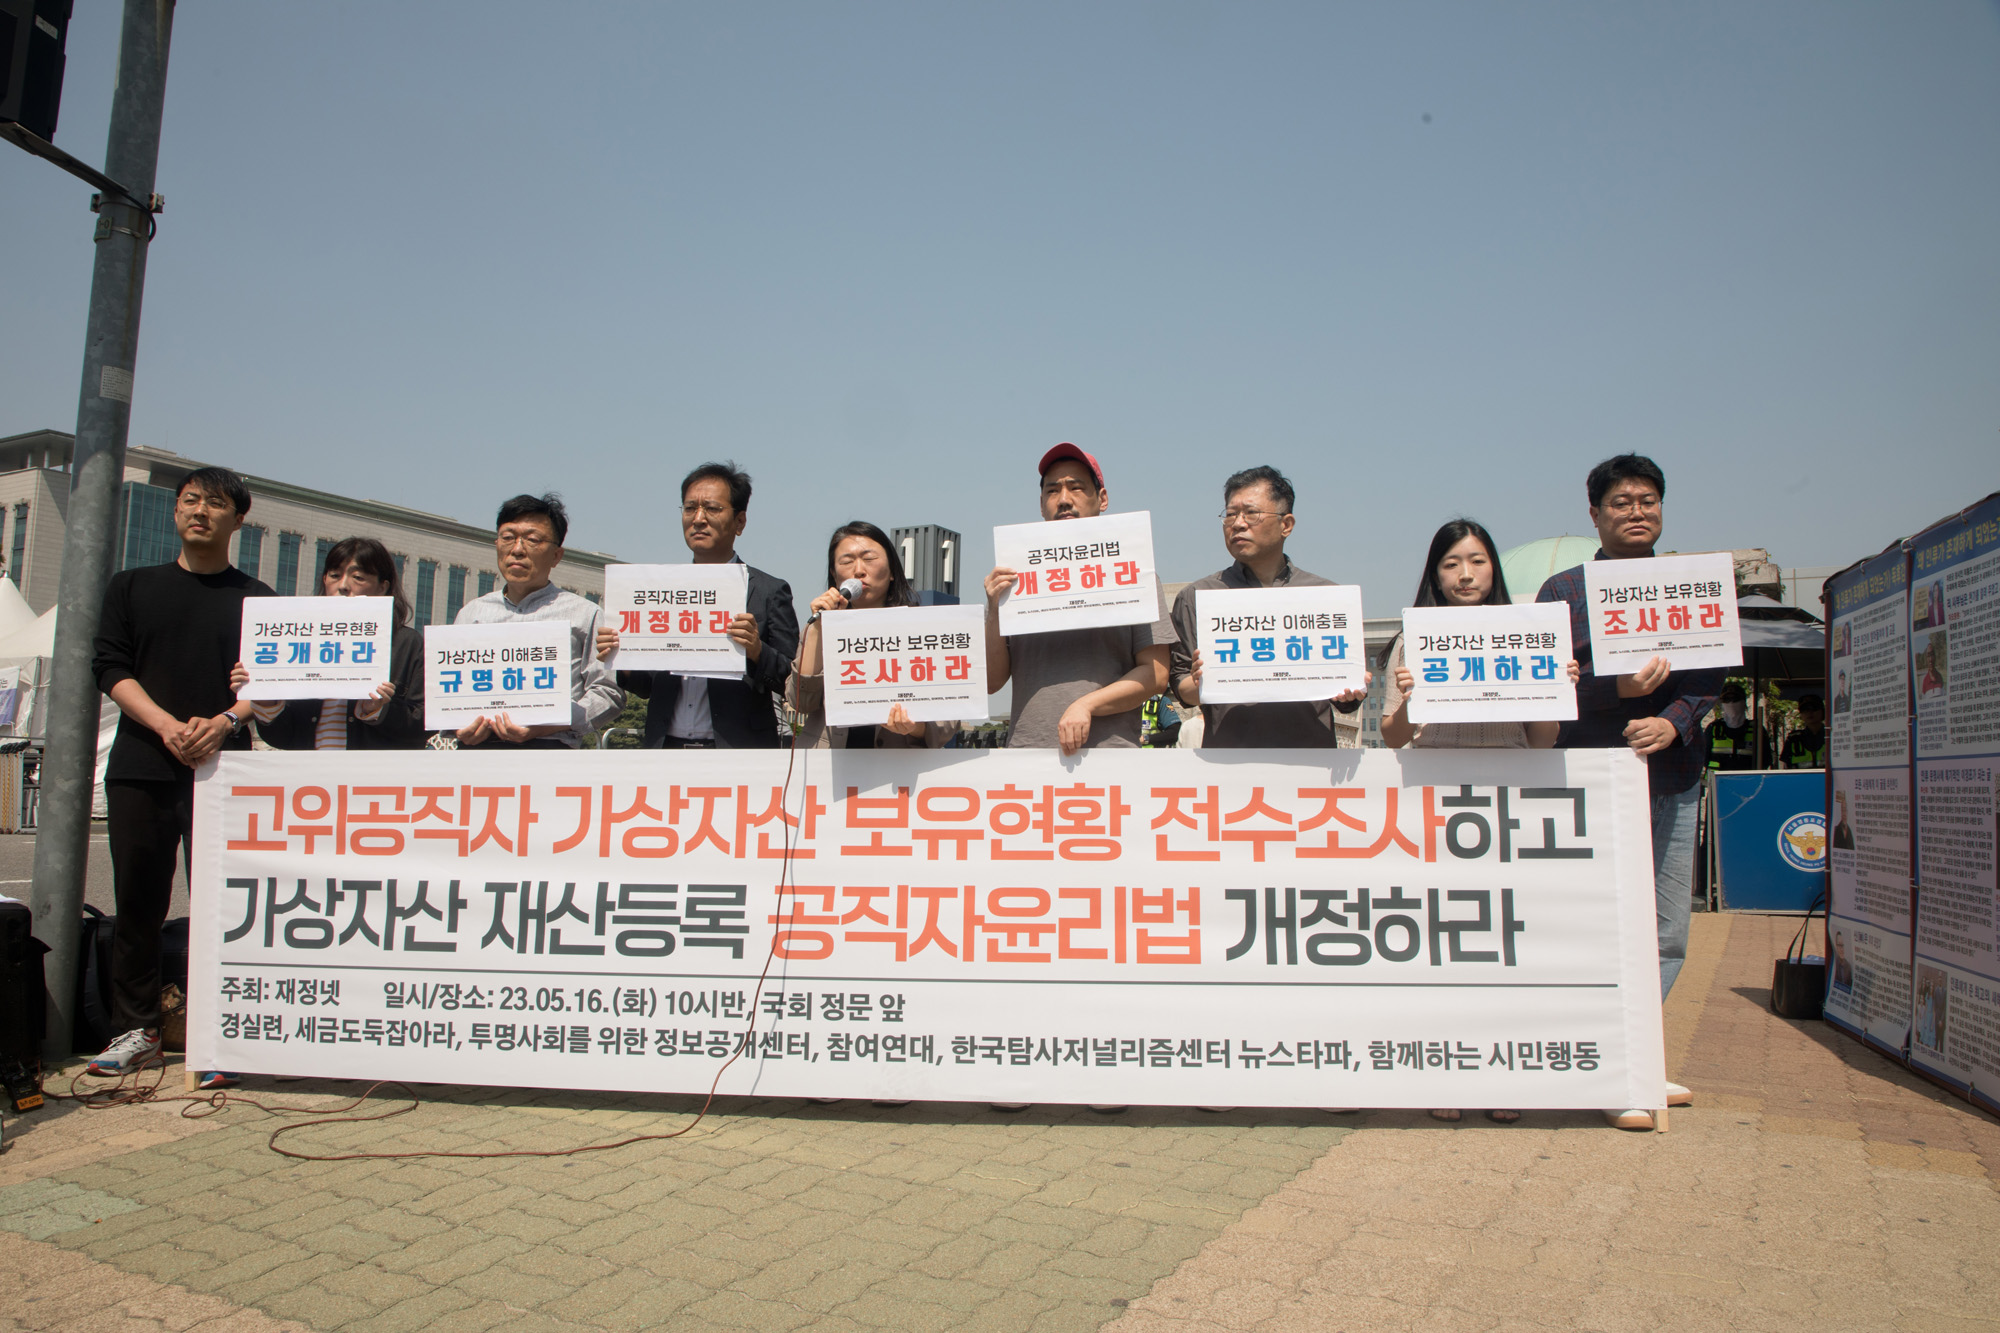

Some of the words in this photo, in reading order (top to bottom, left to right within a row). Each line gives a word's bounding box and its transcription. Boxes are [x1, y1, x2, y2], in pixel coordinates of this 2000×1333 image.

[1027, 540, 1120, 565] 공직자윤리법
[1014, 560, 1141, 596] 개정하라
[633, 589, 717, 605] 공직자윤리법
[1599, 585, 1659, 604] 가상자산
[1664, 581, 1722, 600] 보유현황
[255, 622, 314, 637] 가상자산
[319, 621, 378, 636] 보유현황
[618, 609, 734, 634] 개정하라
[1211, 615, 1277, 633] 가상자산
[1283, 613, 1348, 630] 이해충돌
[1603, 603, 1725, 636] 조사하라
[254, 640, 376, 665] 공개하라
[837, 635, 902, 654] 가상자산
[907, 632, 971, 651] 보유현황
[1214, 635, 1349, 663] 규명하라
[1419, 634, 1485, 652] 가상자산
[1491, 632, 1557, 650] 보유현황
[437, 648, 496, 665] 가상자산
[501, 646, 558, 663] 이해충돌
[439, 666, 557, 693] 규명하라
[839, 655, 972, 686] 조사하라
[1422, 655, 1559, 683] 공개하라
[226, 784, 540, 858] 고위공직자
[552, 784, 827, 860] 가상자산
[839, 782, 1132, 862] 보유현황
[1150, 784, 1593, 863] 전수조사하고
[223, 876, 468, 953] 가상자산
[481, 880, 750, 959] 재산등록
[767, 884, 1202, 965] 공직자윤리법
[1225, 886, 1525, 967] 개정하라
[220, 976, 269, 1004] 주최:
[274, 978, 340, 1007] 재정넷
[383, 981, 494, 1011] 일시/장소:
[499, 986, 657, 1018] 23.05.16.(화)
[664, 990, 754, 1021] 10시반,
[760, 991, 812, 1021] 국회
[820, 992, 873, 1021] 정문
[879, 993, 906, 1022] 앞
[221, 1012, 289, 1044] 경실련,
[294, 1016, 462, 1051] 세금도둑잡아라,
[468, 1023, 592, 1054] 투명사회를
[597, 1027, 648, 1056] 위한
[654, 1028, 819, 1063] 정보공개센터,
[826, 1033, 944, 1066] 참여연대,
[951, 1035, 1230, 1069] 한국탐사저널리즘센터
[1238, 1040, 1361, 1072] 뉴스타파,
[1368, 1040, 1482, 1071] 함께하는
[1488, 1041, 1601, 1071] 시민행동
